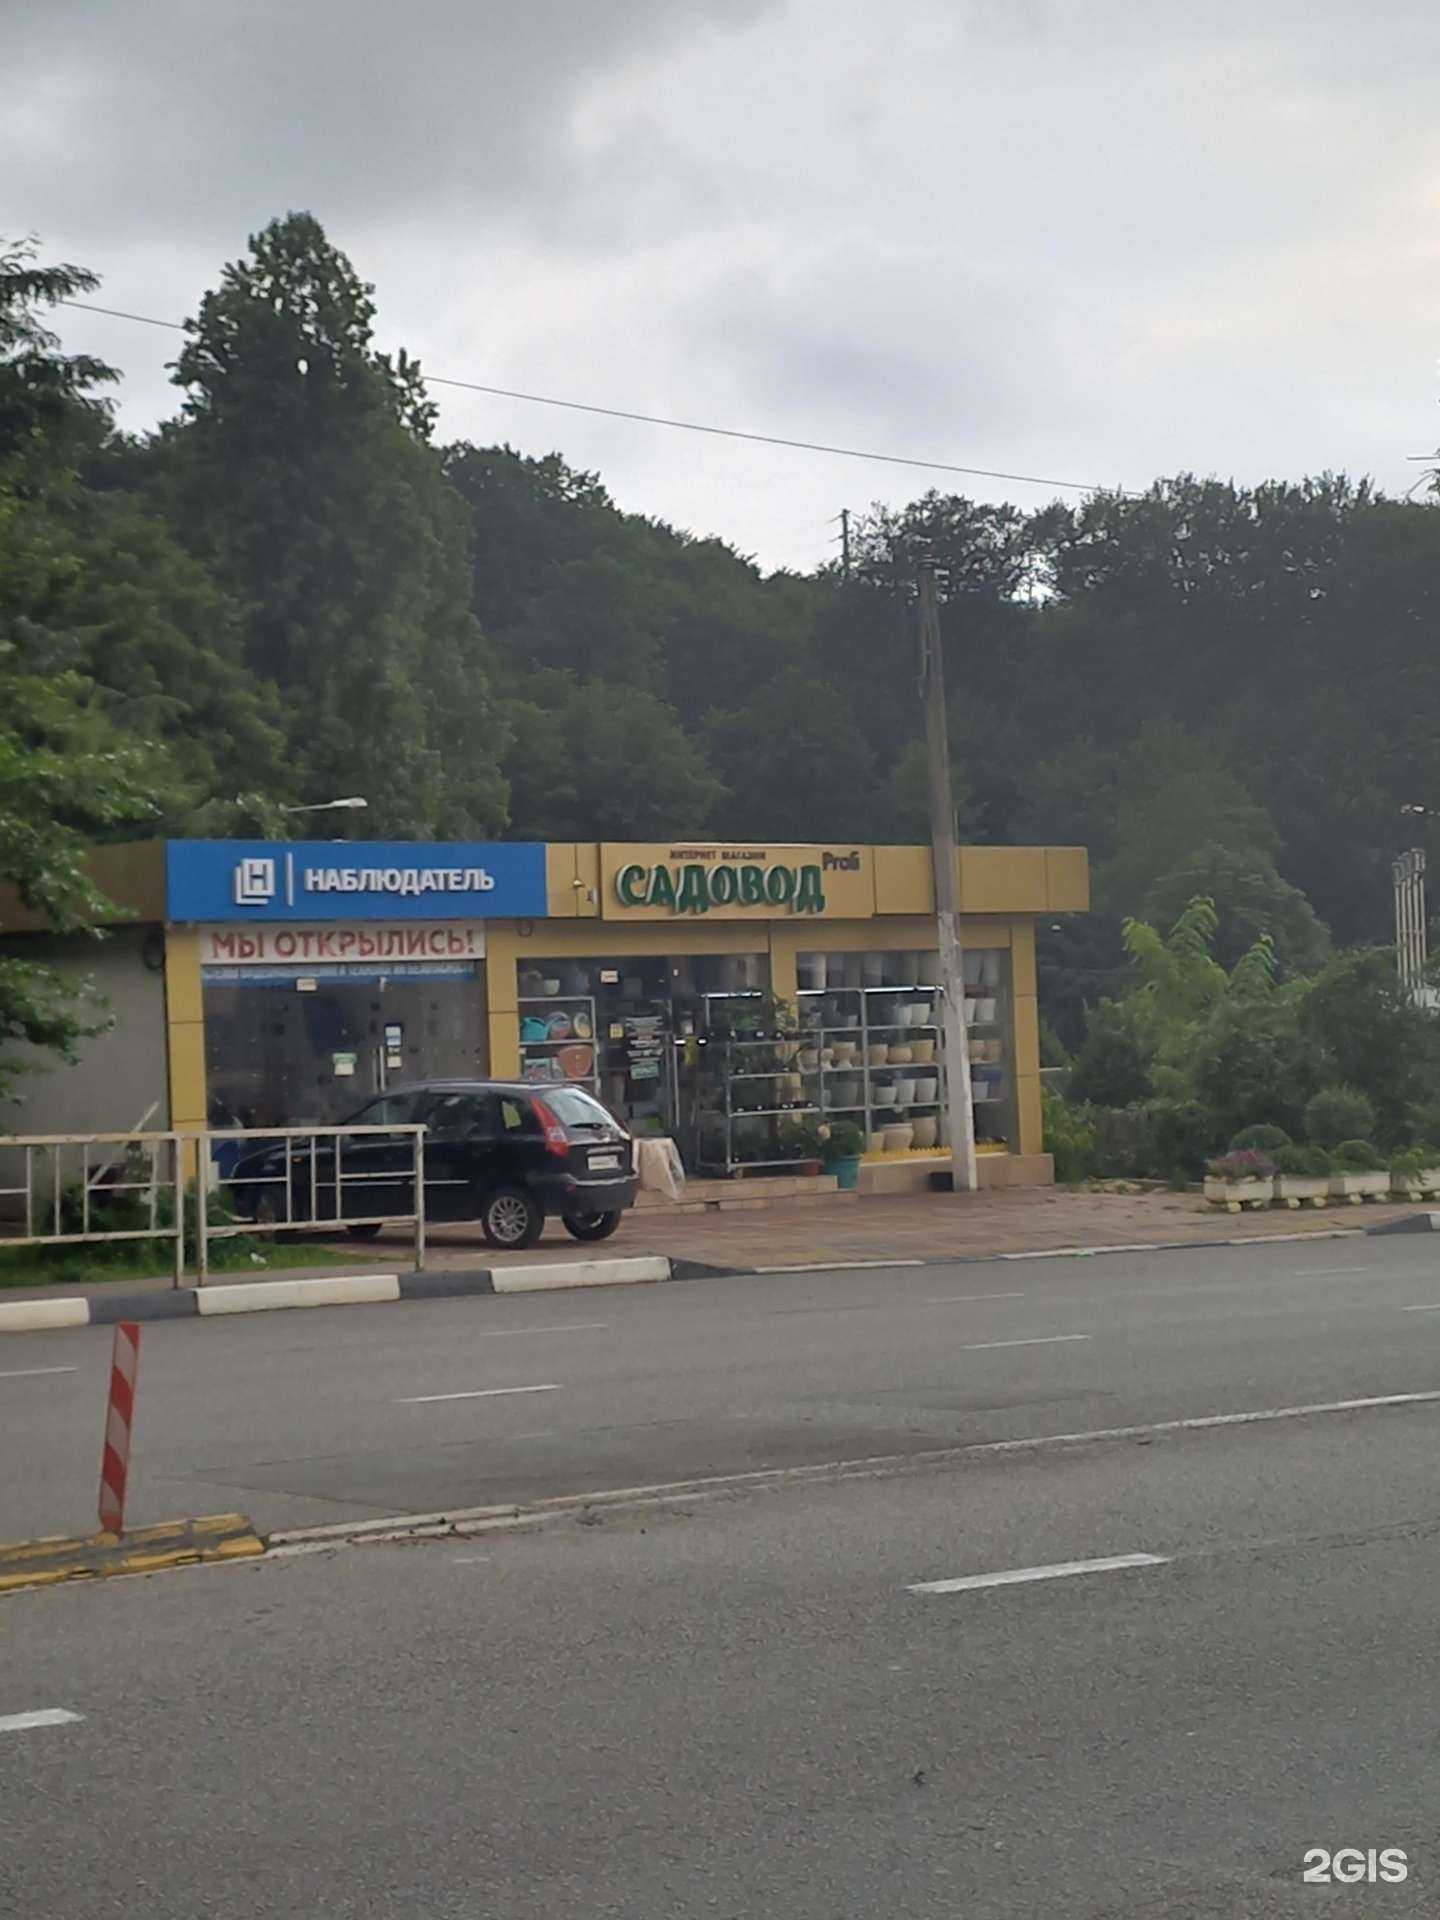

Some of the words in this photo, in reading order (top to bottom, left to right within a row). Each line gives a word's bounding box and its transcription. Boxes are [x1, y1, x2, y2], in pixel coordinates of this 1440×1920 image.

[304, 868, 495, 895] НАБЛЮДАТЕЛЬ
[616, 865, 826, 914] САДОВОД
[211, 931, 263, 959] МЫ
[274, 928, 476, 957] ОТКРЫЛИСЬ!
